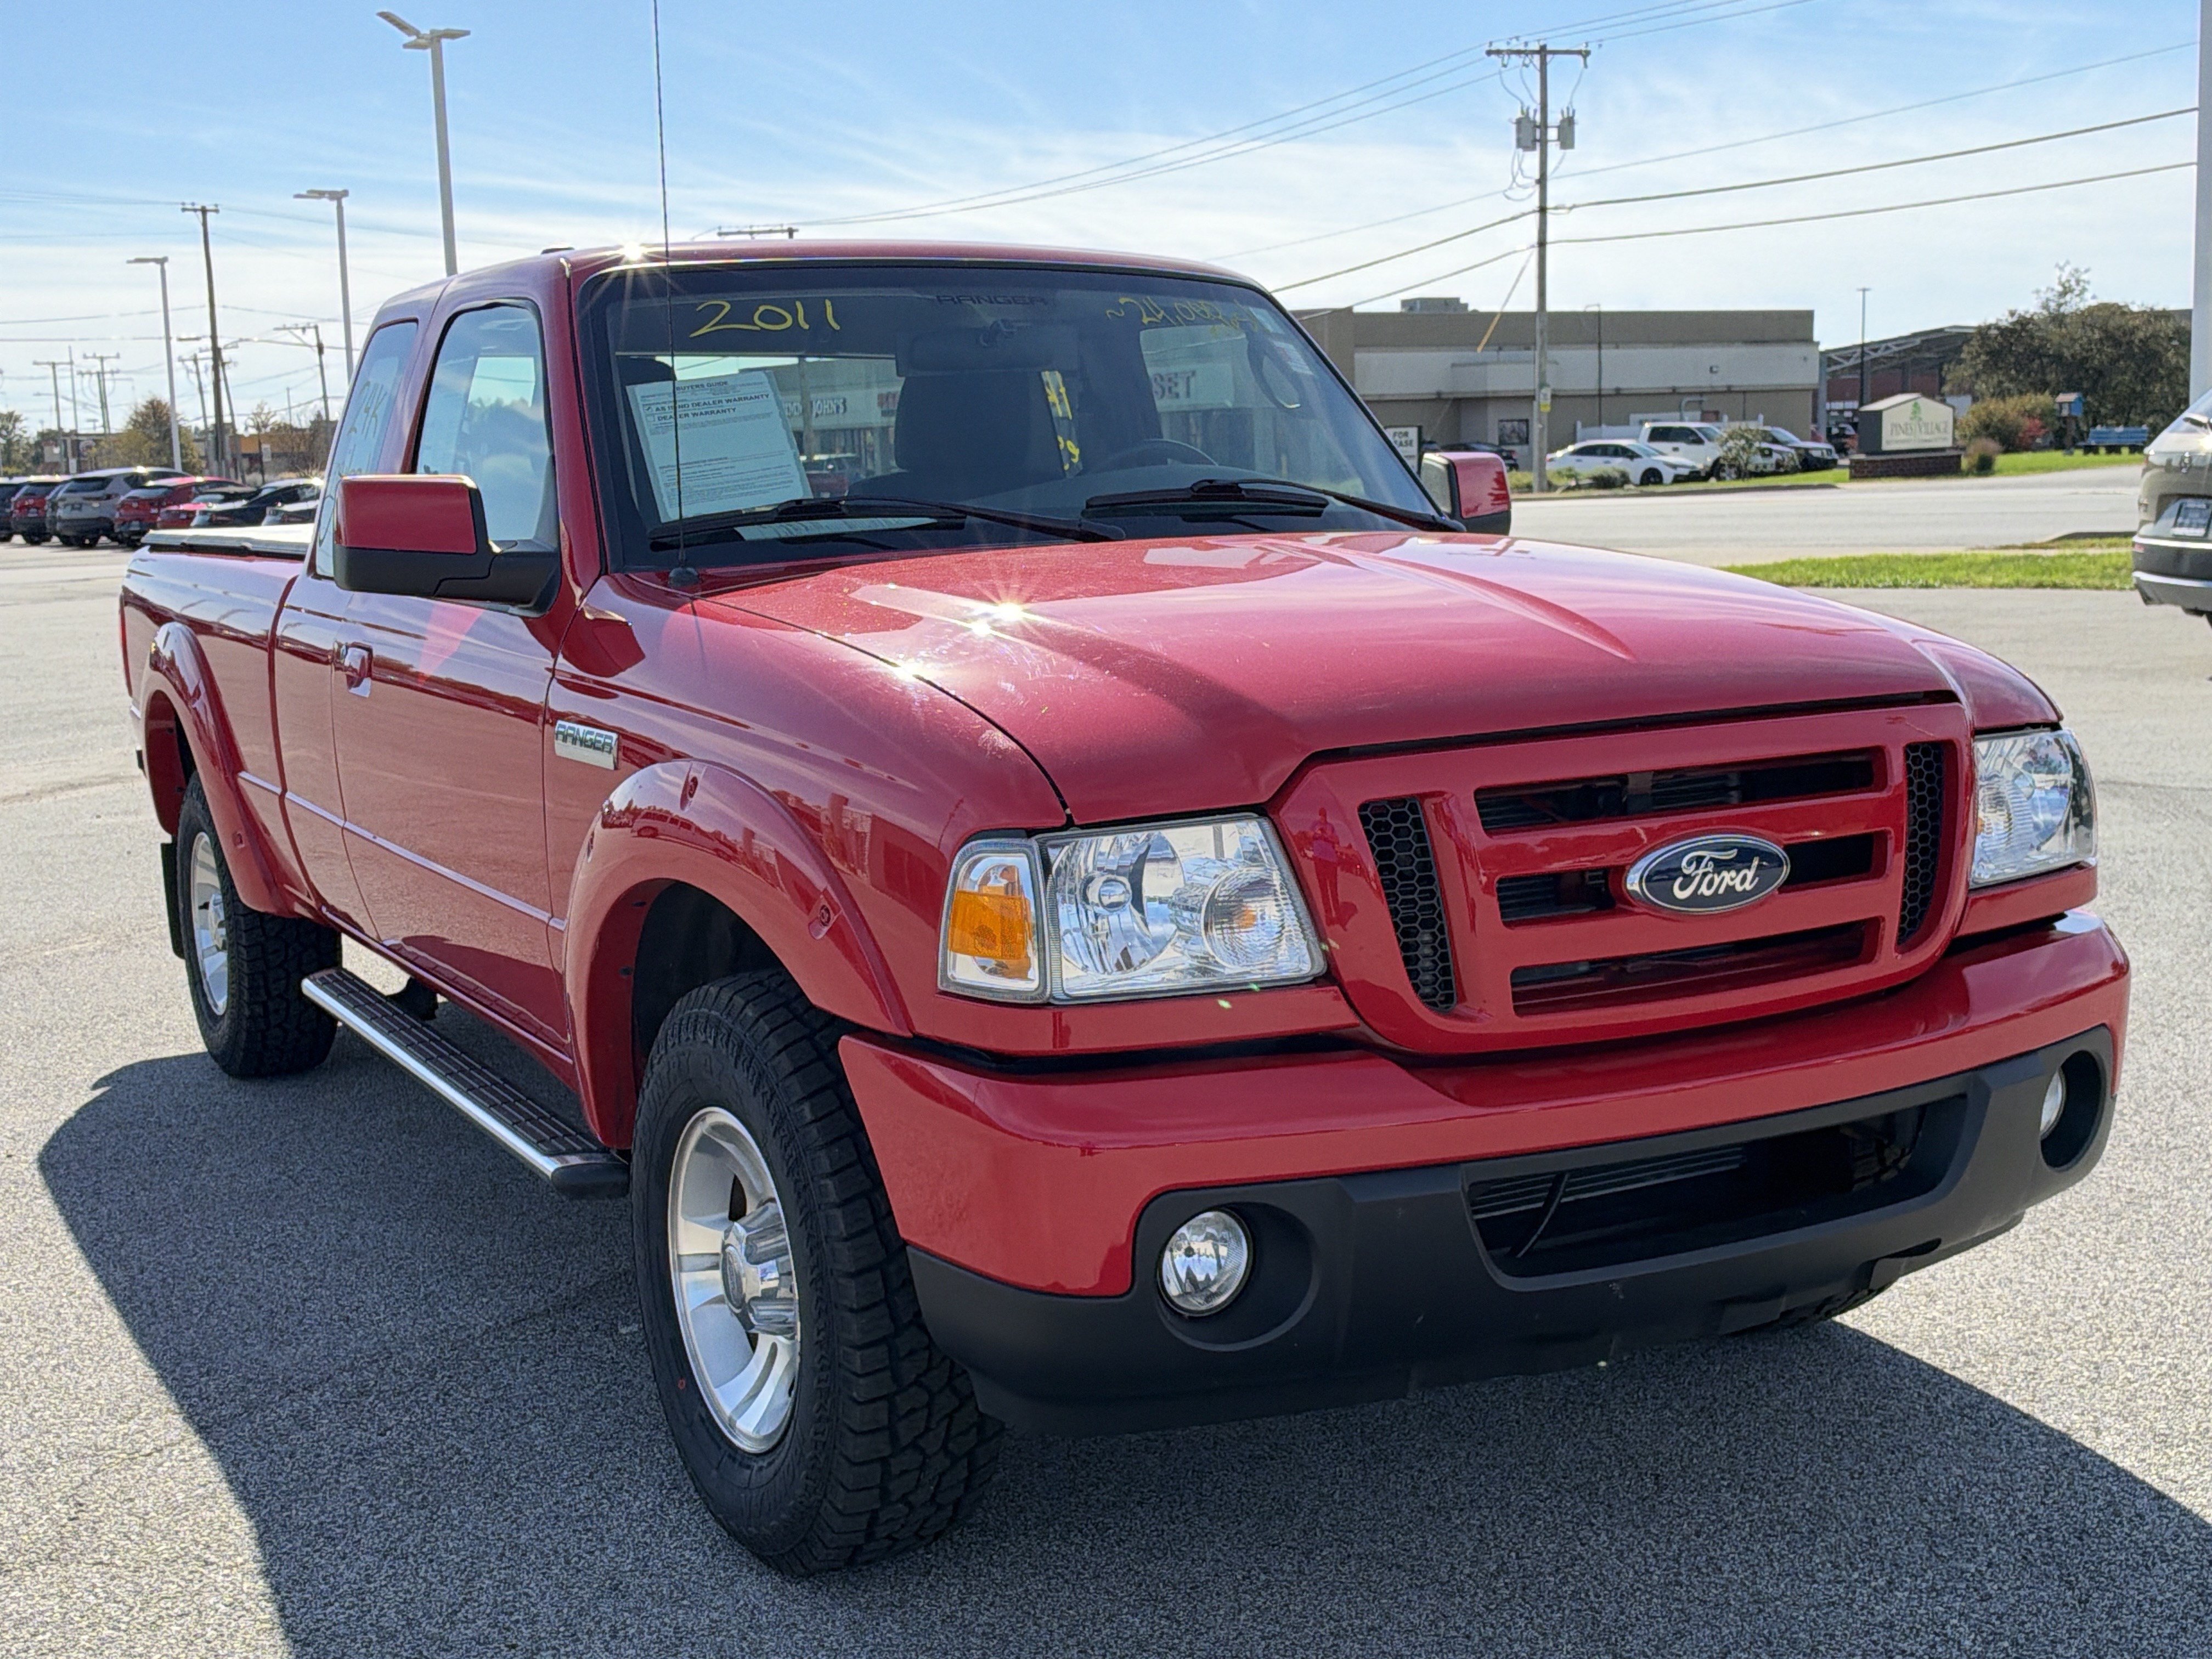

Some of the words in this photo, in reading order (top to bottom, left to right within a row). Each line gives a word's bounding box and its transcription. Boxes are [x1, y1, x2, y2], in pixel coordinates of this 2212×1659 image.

[936, 295, 1048, 305] RANGER
[689, 298, 840, 338] 2011
[724, 394, 769, 404] WARRANTY
[657, 413, 690, 421] DEAER
[691, 408, 736, 417] WARRANTY
[555, 723, 613, 754] RANGER
[1673, 849, 1759, 900] Ford
